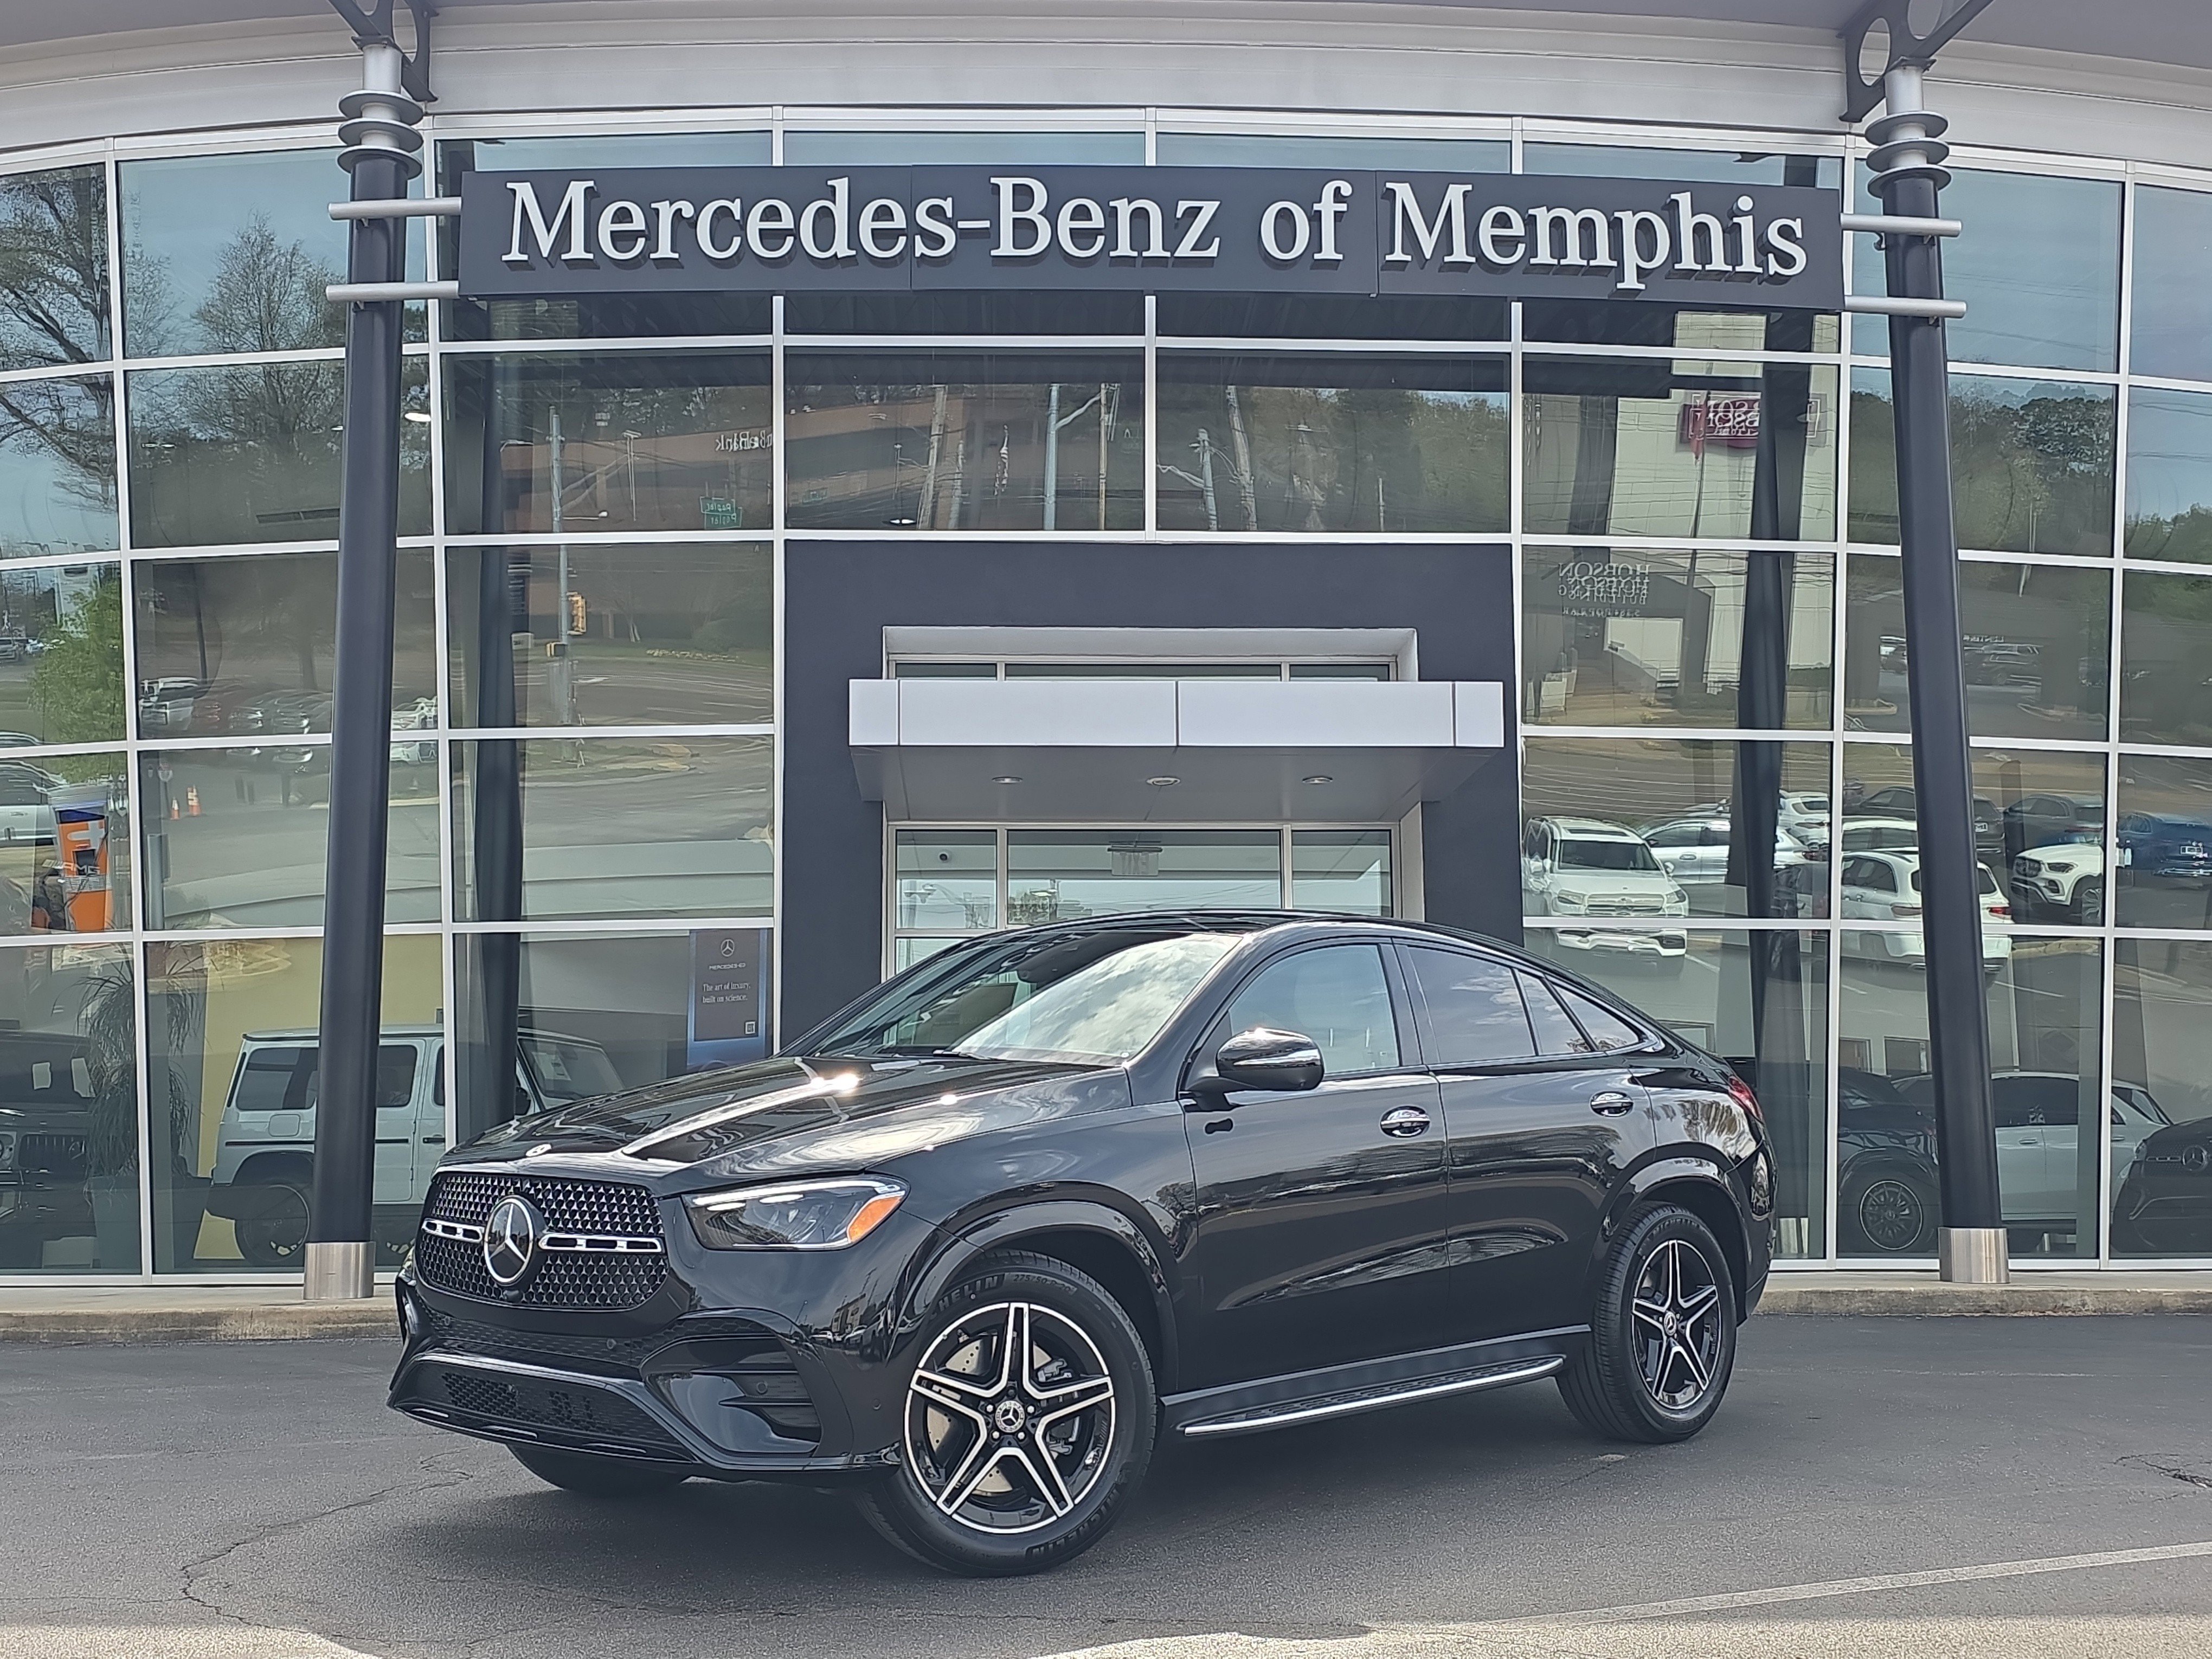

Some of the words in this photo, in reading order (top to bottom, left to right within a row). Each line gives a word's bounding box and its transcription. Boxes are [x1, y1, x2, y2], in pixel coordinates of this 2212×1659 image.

[500, 175, 1221, 263] Mercedes-Benz
[1260, 179, 1352, 262] of
[1382, 181, 1808, 291] Memphis
[703, 983, 713, 992] The
